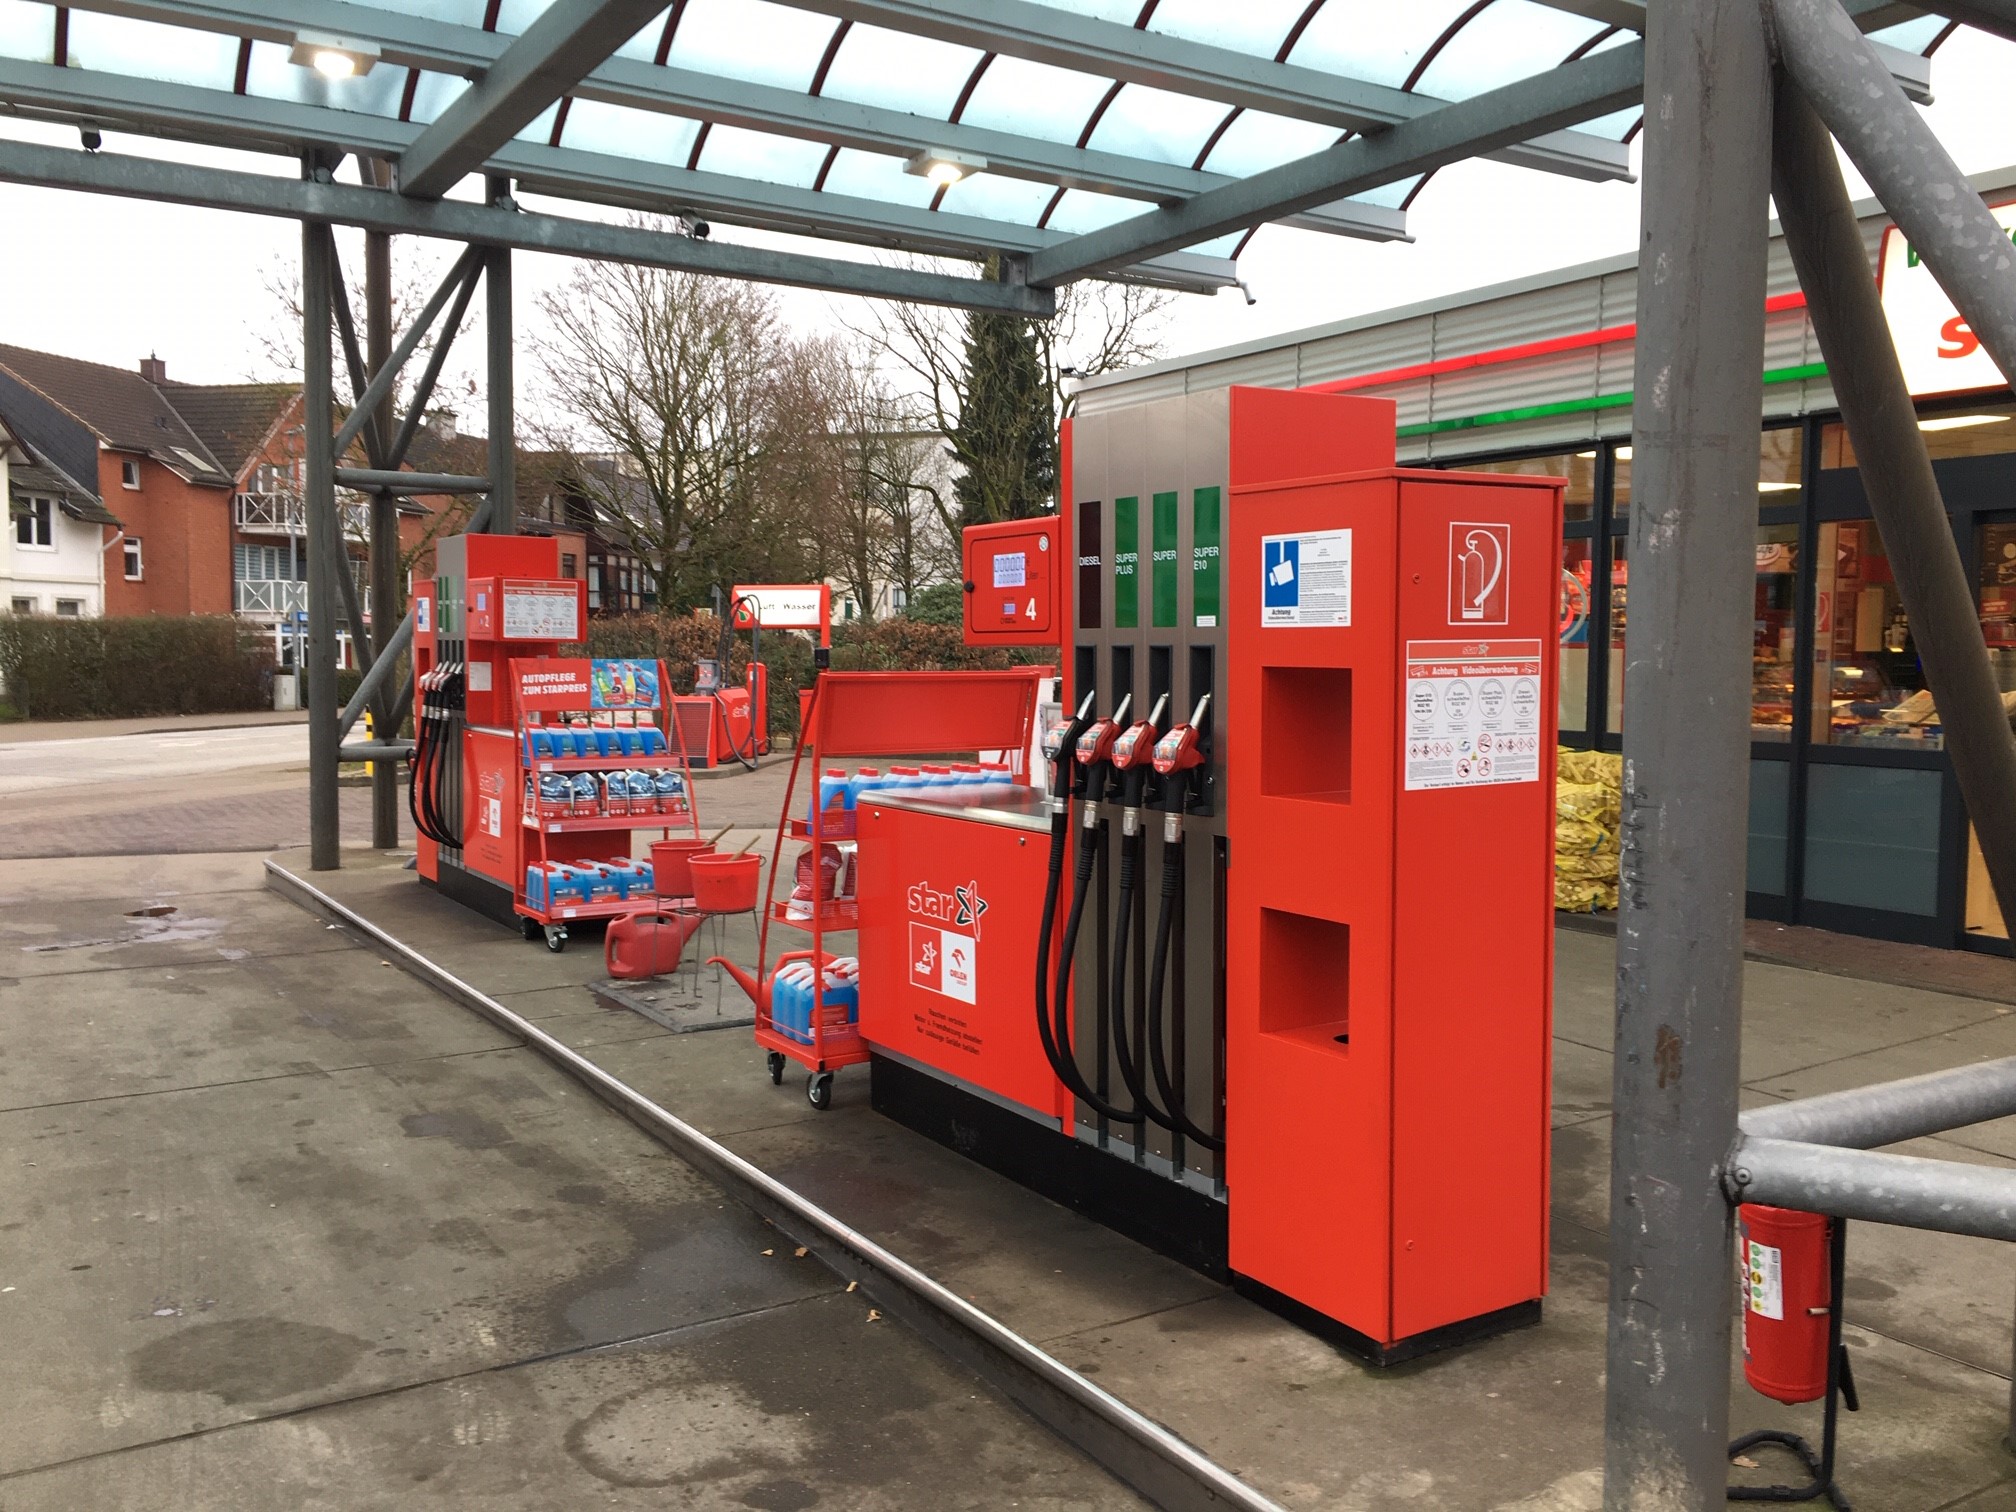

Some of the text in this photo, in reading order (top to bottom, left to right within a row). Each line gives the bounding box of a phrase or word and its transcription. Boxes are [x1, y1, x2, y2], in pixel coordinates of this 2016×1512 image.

[1115, 552, 1138, 564] SUPER
[1153, 550, 1177, 561] SUPER
[1194, 546, 1219, 558] SUPER
[1079, 556, 1101, 566] DIESEL
[1193, 560, 1207, 570] E10
[1115, 564, 1133, 575] PLUS
[1025, 597, 1037, 621] 4
[1432, 665, 1518, 676] Achtung Videoüberwachung
[521, 672, 576, 684] AUTOPFLEGE
[522, 683, 588, 695] ZUM STARPREIS
[907, 880, 954, 922] star
